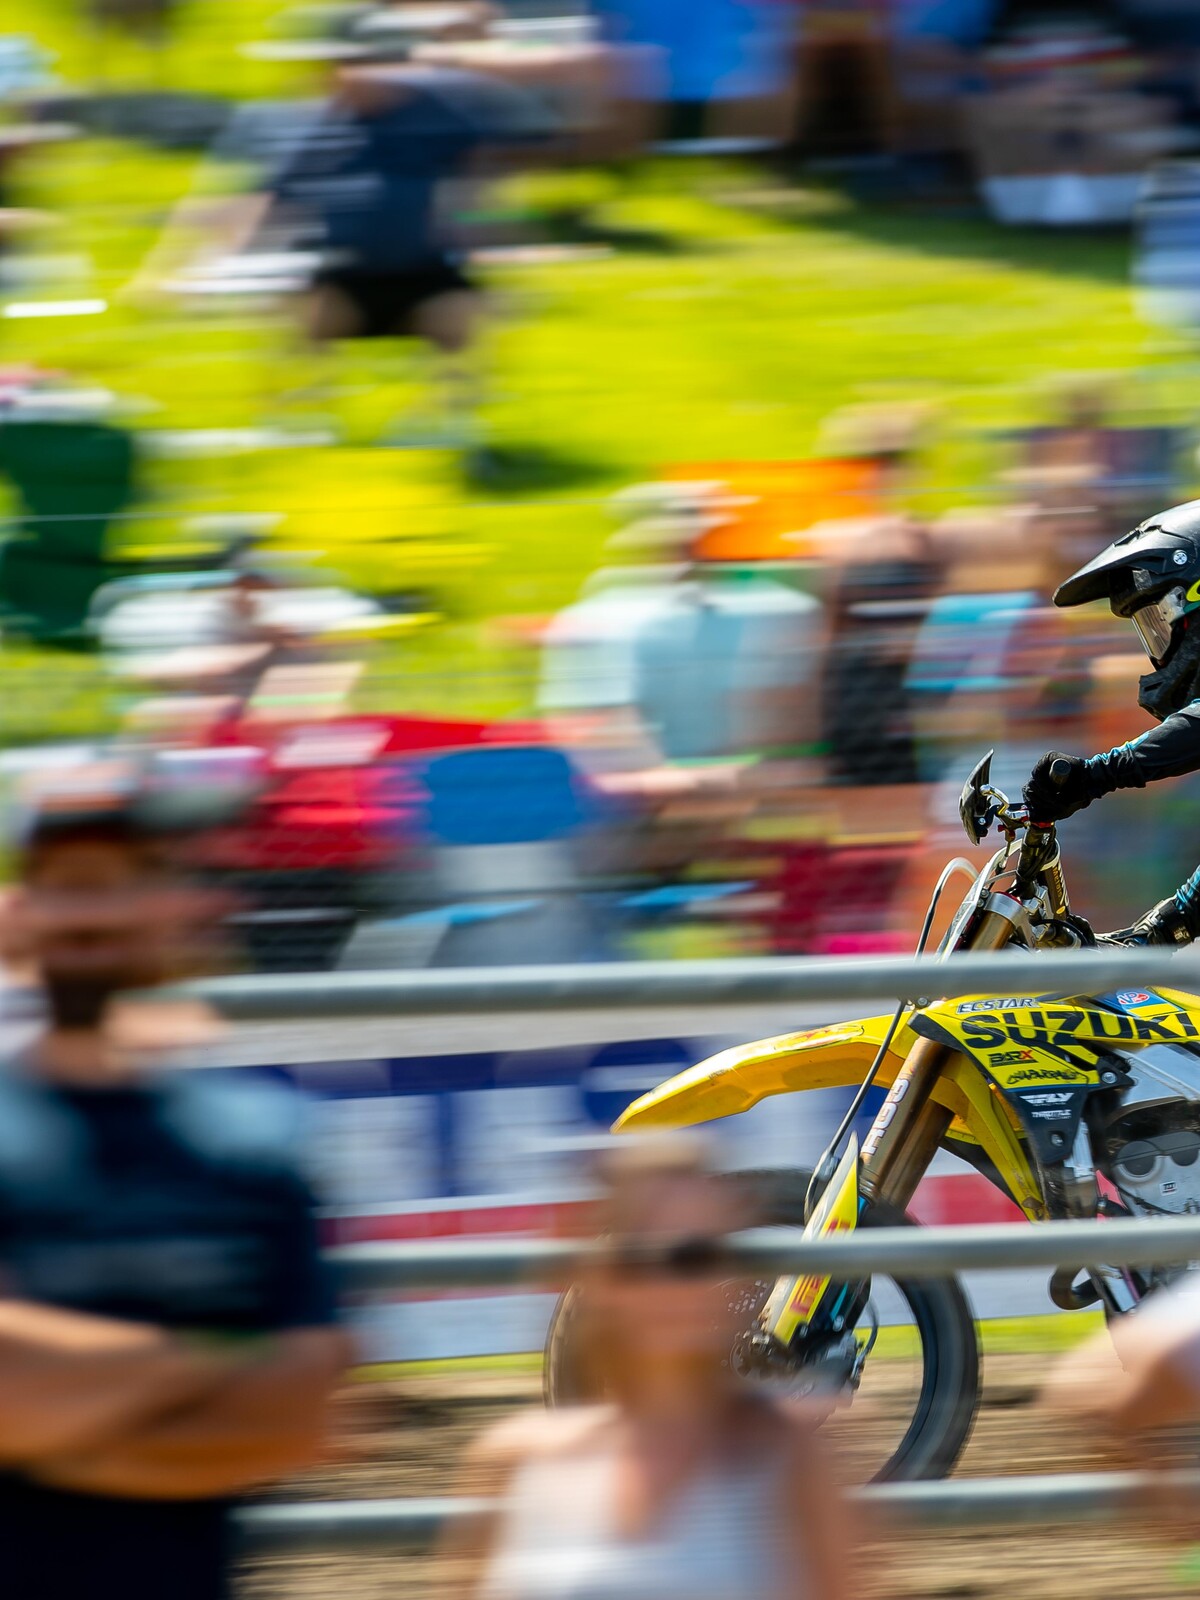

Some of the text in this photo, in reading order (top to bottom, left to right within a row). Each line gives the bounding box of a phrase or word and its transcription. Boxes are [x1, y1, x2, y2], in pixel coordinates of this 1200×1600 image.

[958, 998, 1034, 1014] ECSTAR
[961, 1011, 1199, 1049] SUZUKI
[988, 1050, 1034, 1064] BARX
[1019, 1092, 1075, 1104] FLY
